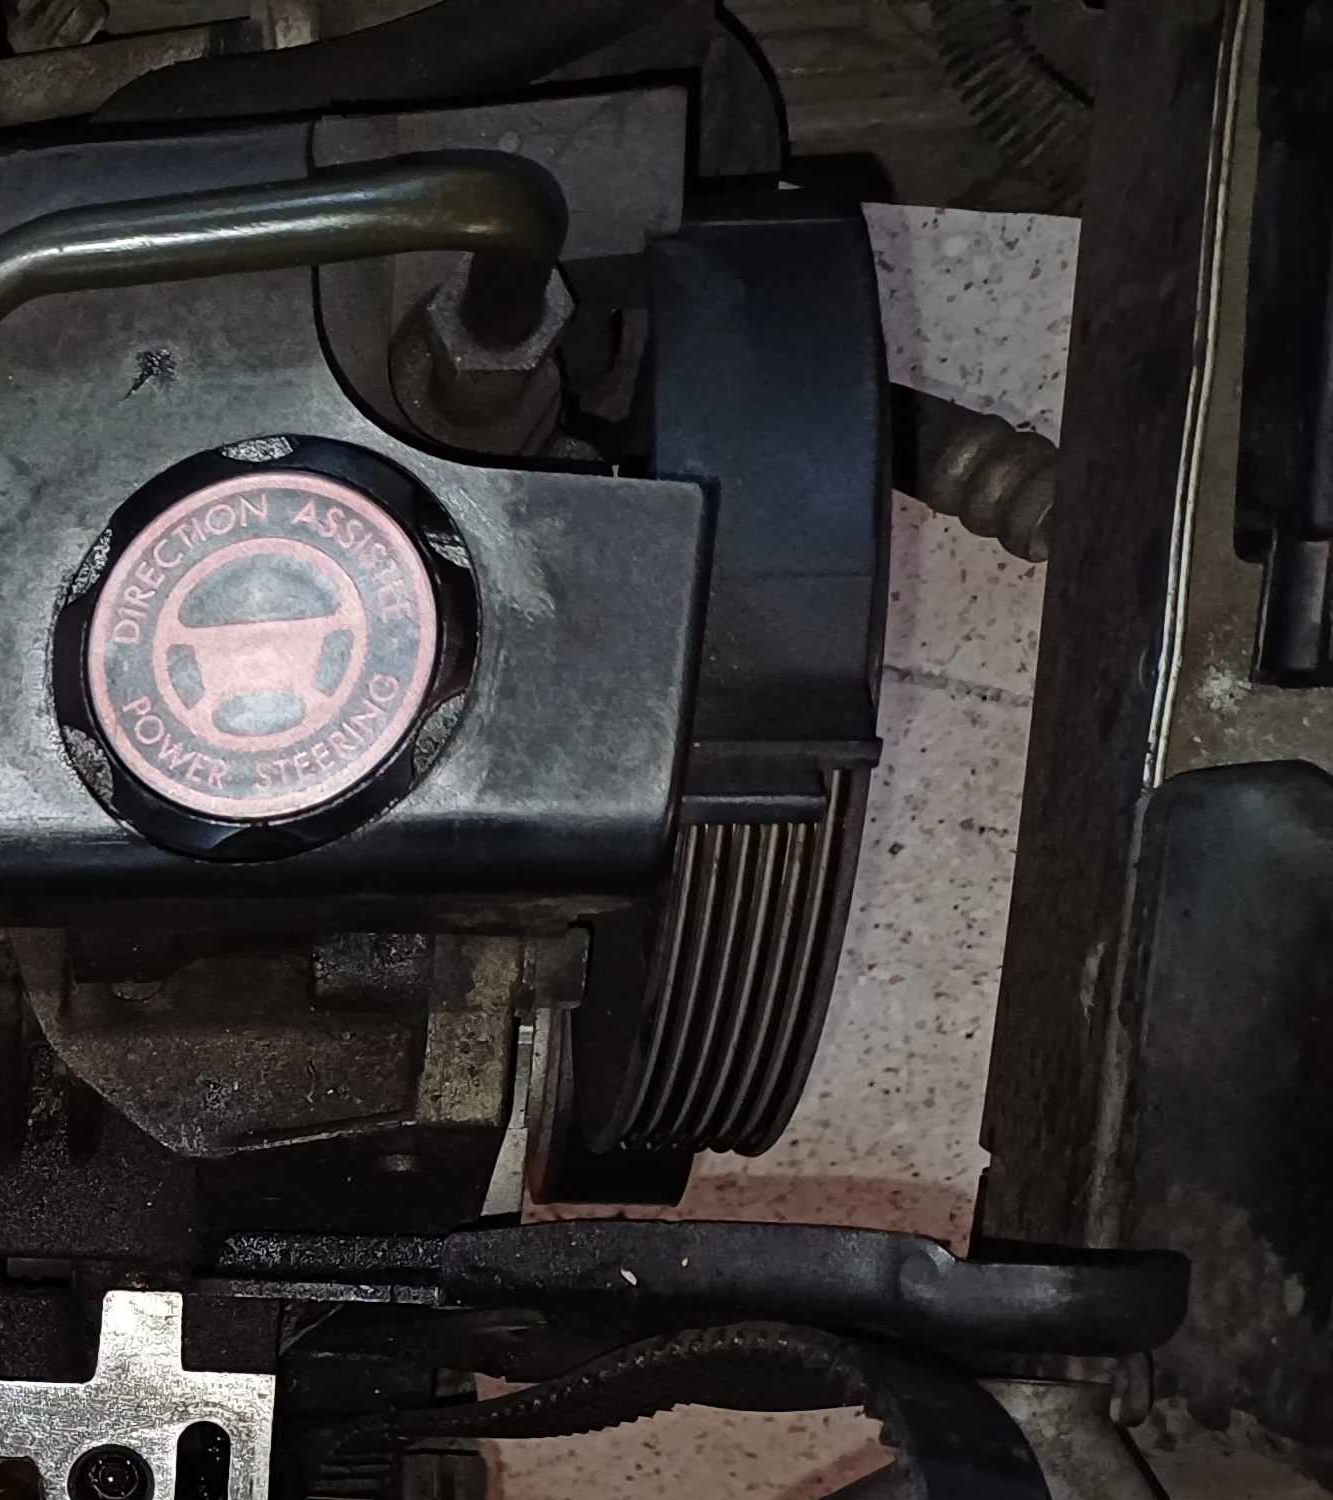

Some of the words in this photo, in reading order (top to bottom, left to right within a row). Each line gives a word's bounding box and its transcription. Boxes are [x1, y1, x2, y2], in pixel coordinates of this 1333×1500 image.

[112, 493, 269, 645] DIRECTION
[122, 697, 229, 789] POWER
[255, 673, 400, 791] STEERING
